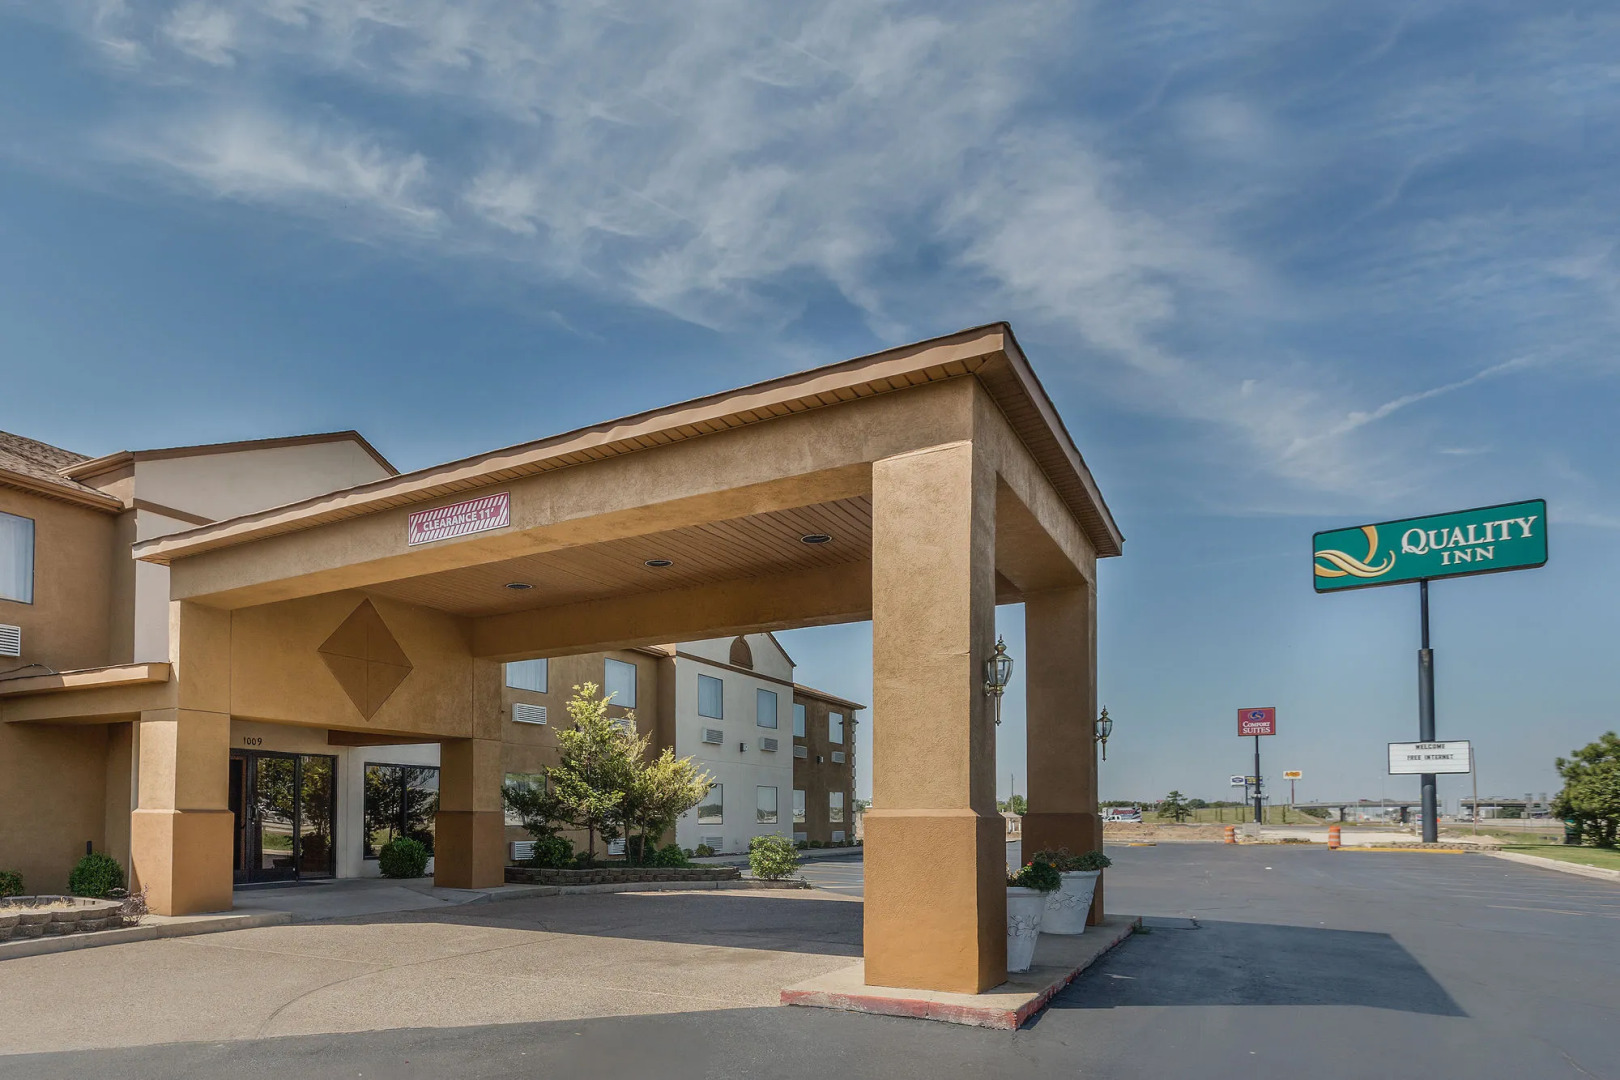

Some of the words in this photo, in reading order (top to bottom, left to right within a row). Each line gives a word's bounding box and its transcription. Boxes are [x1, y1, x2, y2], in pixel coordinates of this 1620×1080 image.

[423, 513, 477, 531] CLEARANCE
[1401, 515, 1538, 555] QUALITY
[1441, 546, 1495, 566] INN
[243, 736, 263, 746] 1009
